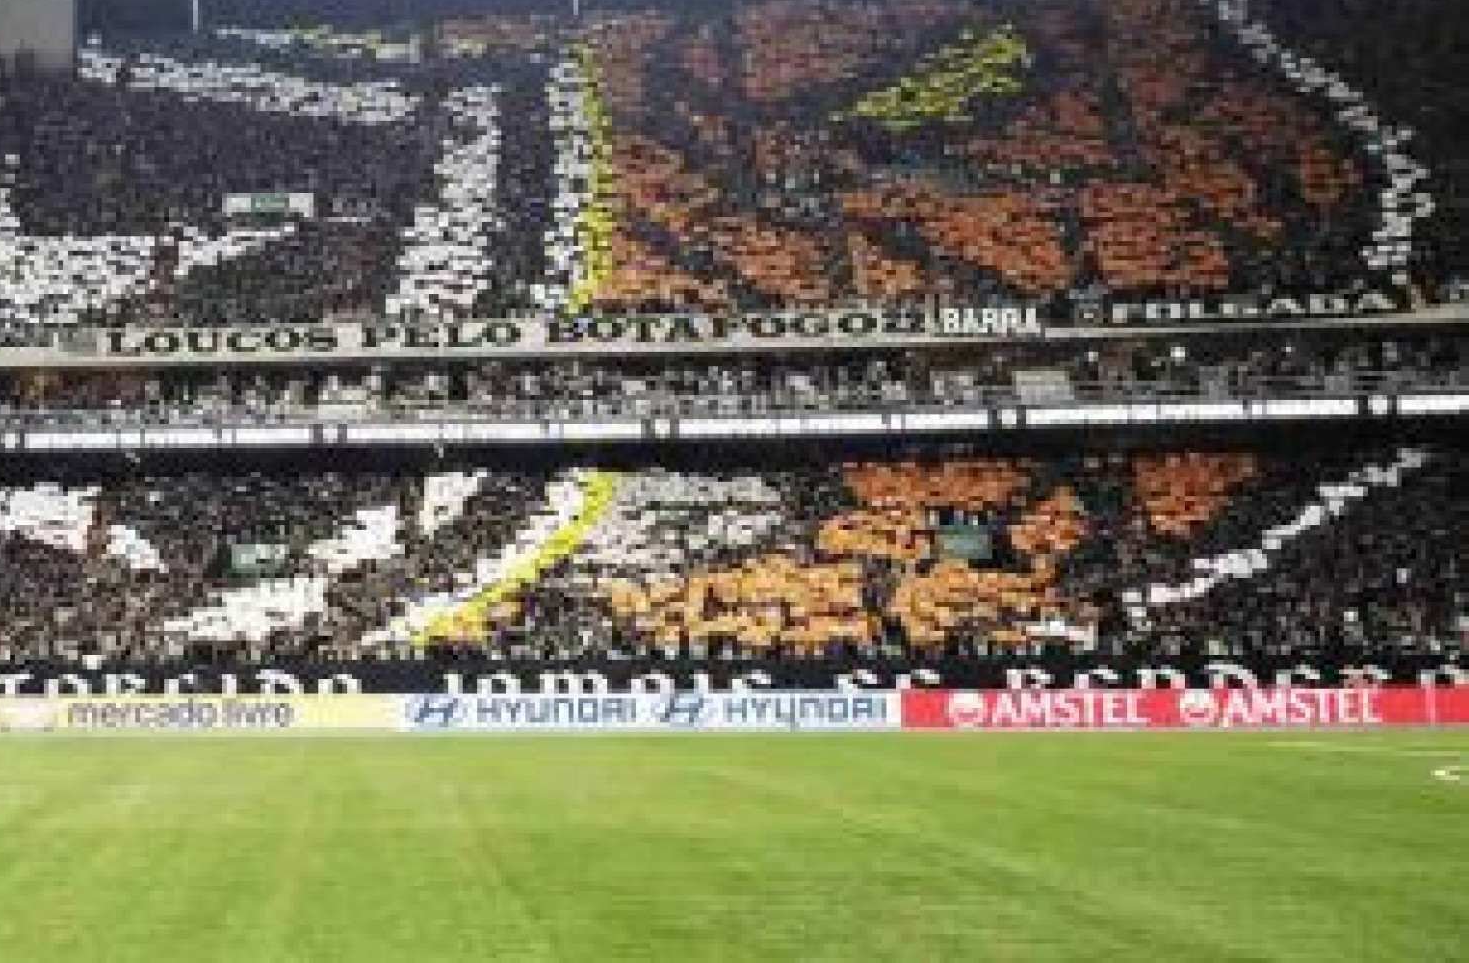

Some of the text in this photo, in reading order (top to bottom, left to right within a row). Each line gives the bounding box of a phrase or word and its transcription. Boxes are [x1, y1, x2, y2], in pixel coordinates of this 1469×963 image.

[106, 328, 339, 356] LOUCOS
[362, 321, 521, 350] PELO
[67, 699, 295, 728] mercado livre
[477, 698, 637, 723] HYUNDAI
[724, 697, 887, 722] HYUNDAI
[991, 689, 1149, 723] AMSTEL
[1224, 688, 1383, 723] AMSTEL
